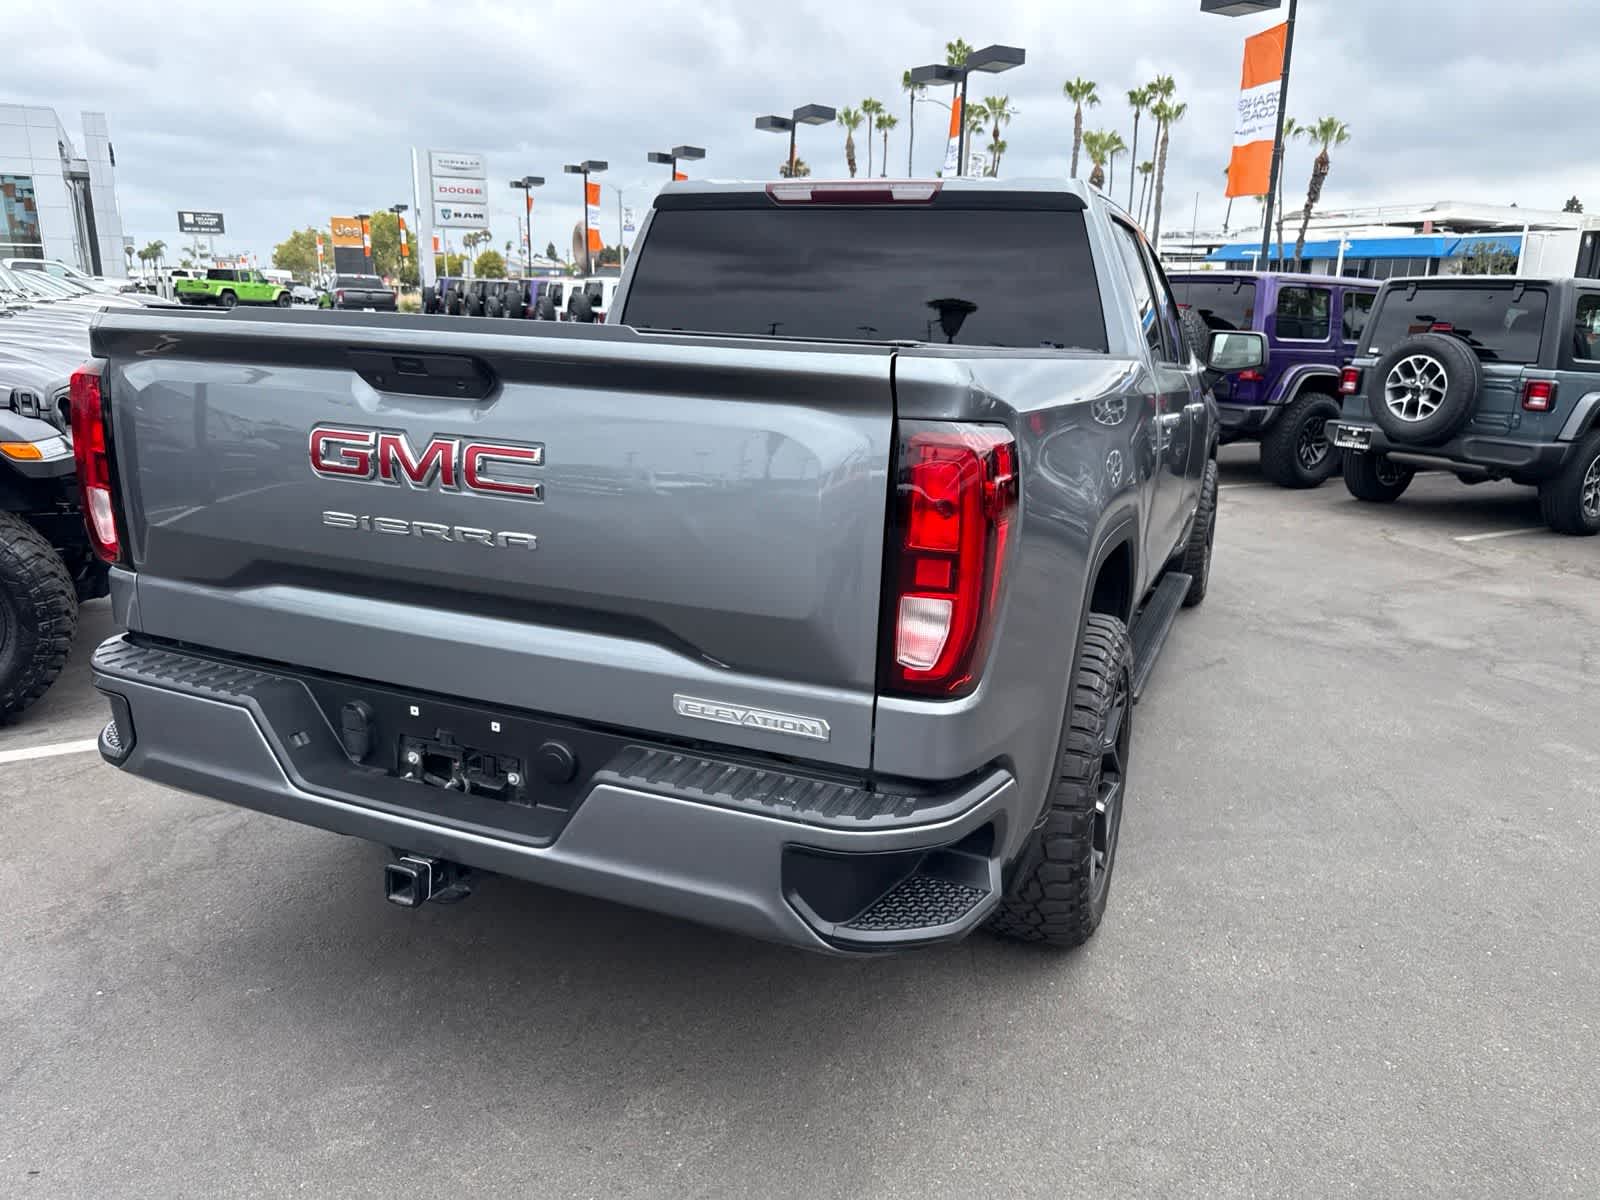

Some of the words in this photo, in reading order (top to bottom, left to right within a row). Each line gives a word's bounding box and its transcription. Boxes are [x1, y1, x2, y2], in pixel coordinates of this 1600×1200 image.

[309, 426, 543, 501] GMC
[322, 510, 537, 550] SIERRA
[685, 703, 818, 735] ELEVATION
